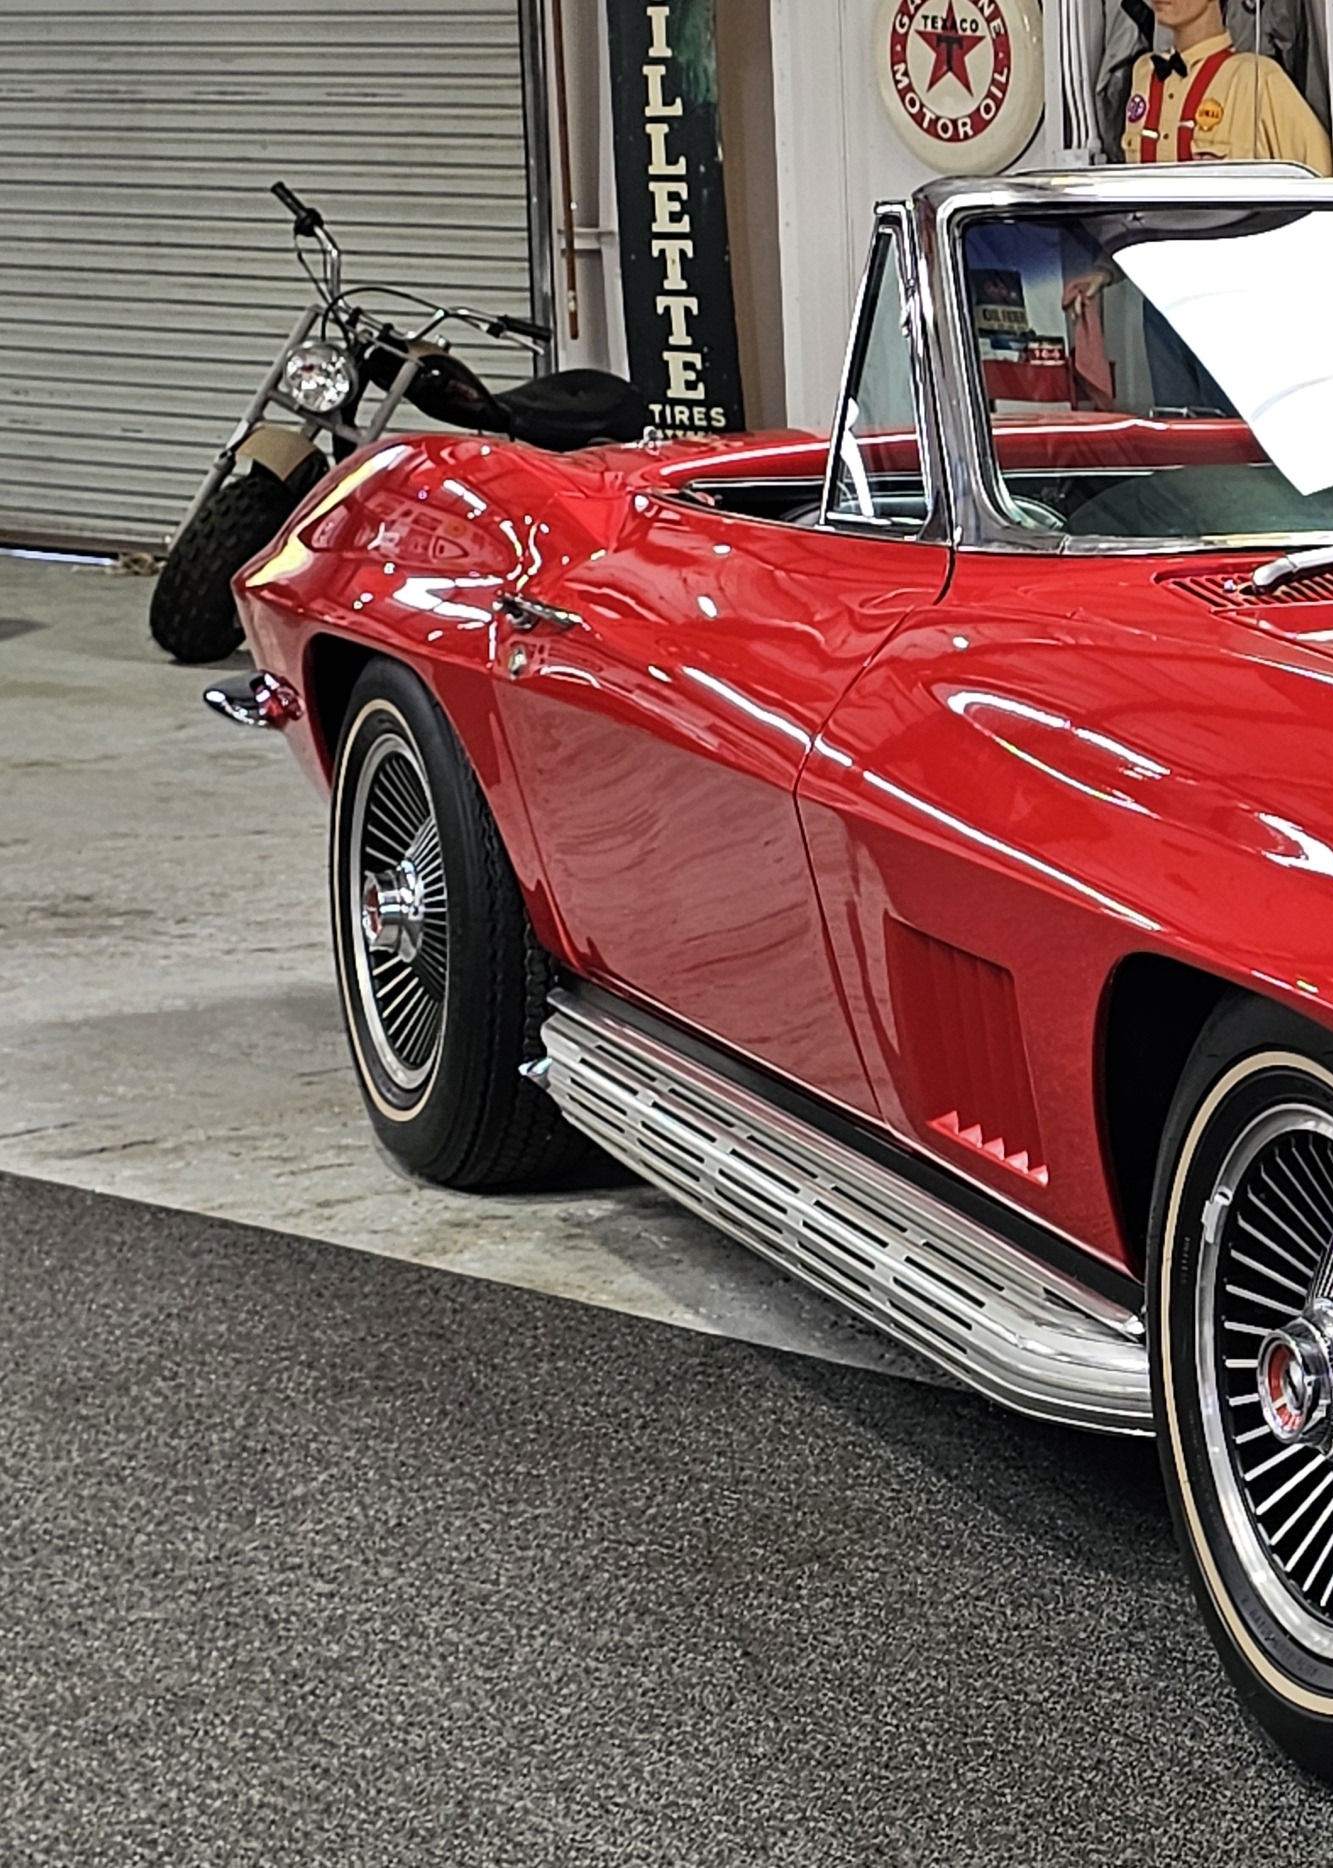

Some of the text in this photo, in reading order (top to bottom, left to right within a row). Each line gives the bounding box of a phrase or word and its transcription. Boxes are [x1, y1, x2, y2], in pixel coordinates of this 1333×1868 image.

[921, 14, 980, 33] TEXACO
[893, 62, 1008, 139] MOTOR OIL
[642, 0, 706, 400] ILLETTE
[648, 403, 727, 428] TIRES
